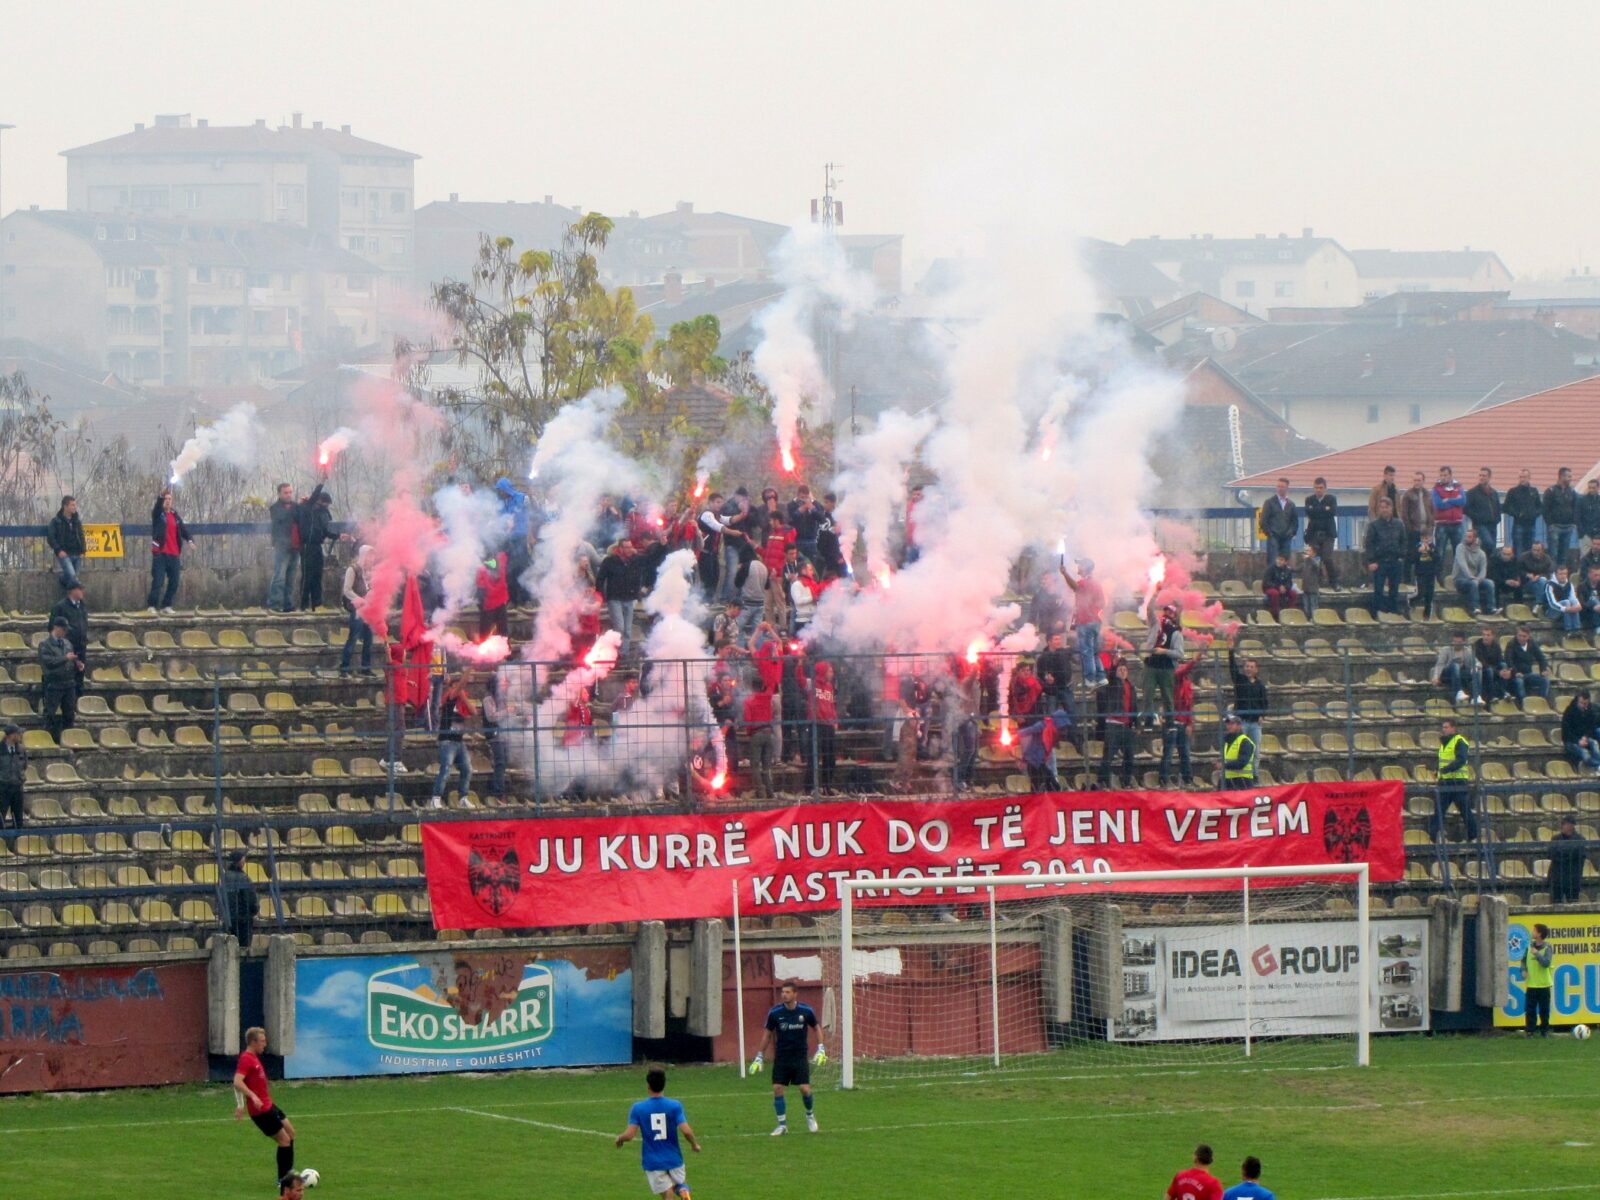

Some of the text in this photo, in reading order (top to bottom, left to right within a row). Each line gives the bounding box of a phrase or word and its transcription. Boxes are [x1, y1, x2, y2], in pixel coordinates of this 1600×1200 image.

[101, 530, 120, 552] 21
[528, 796, 1310, 873] JU KURRË NUK DO TË JENI VETËM
[752, 857, 1112, 905] KASTRIOTËT 2010
[1172, 944, 1360, 978] IDEA GROUP
[1502, 964, 1600, 1017] SCU
[380, 998, 543, 1041] EKO SHARR
[380, 1047, 543, 1067] INDUSTRIA E QUMËSHTIT
[650, 1112, 667, 1141] 9
